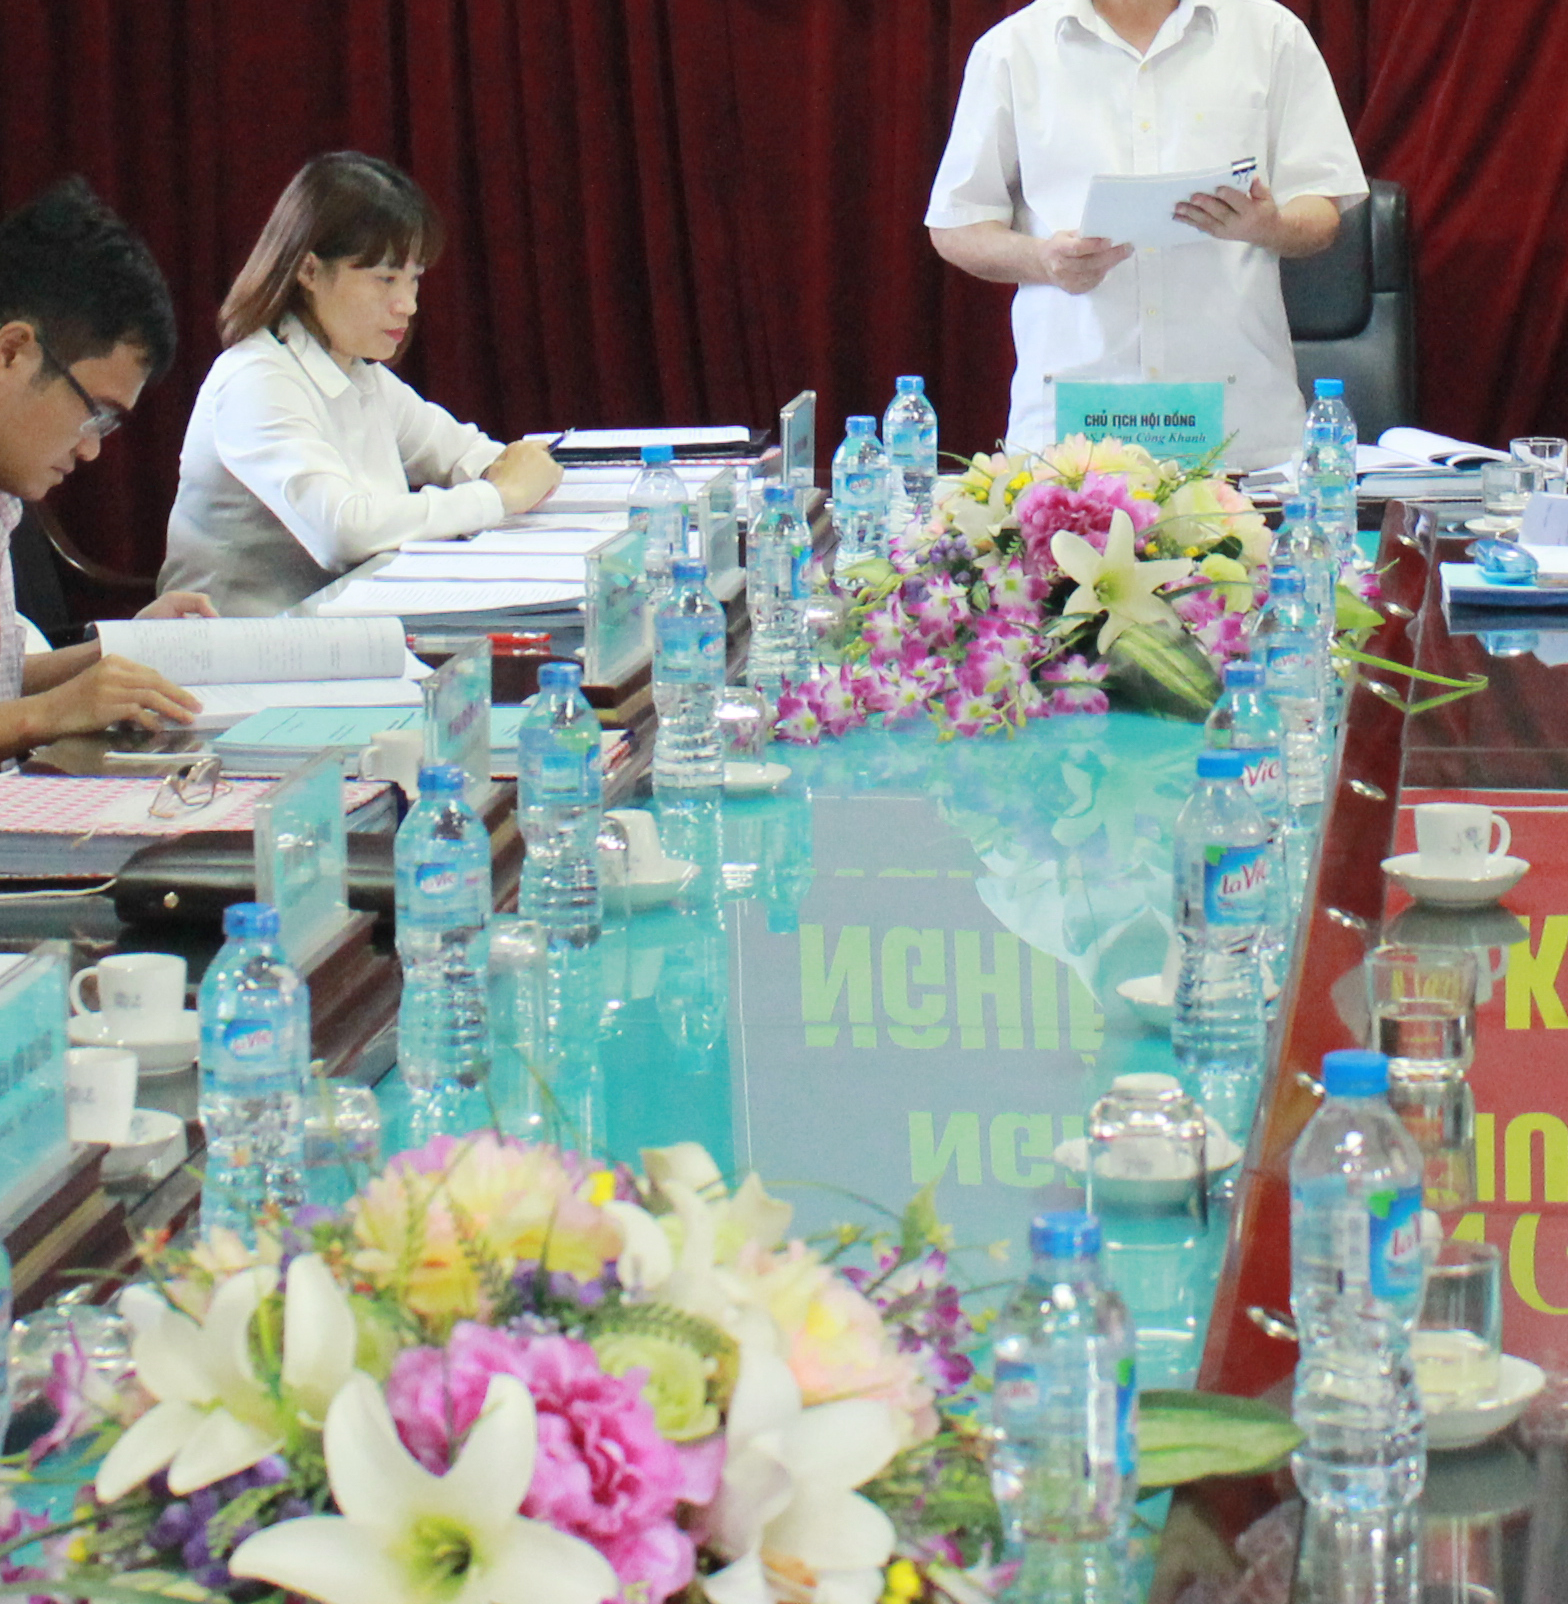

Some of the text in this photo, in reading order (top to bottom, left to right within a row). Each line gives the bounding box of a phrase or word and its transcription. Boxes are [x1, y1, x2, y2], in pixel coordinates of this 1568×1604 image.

[1085, 409, 1108, 427] CHỦ
[1113, 414, 1137, 429] TỊCH
[1141, 412, 1160, 430] HỘI
